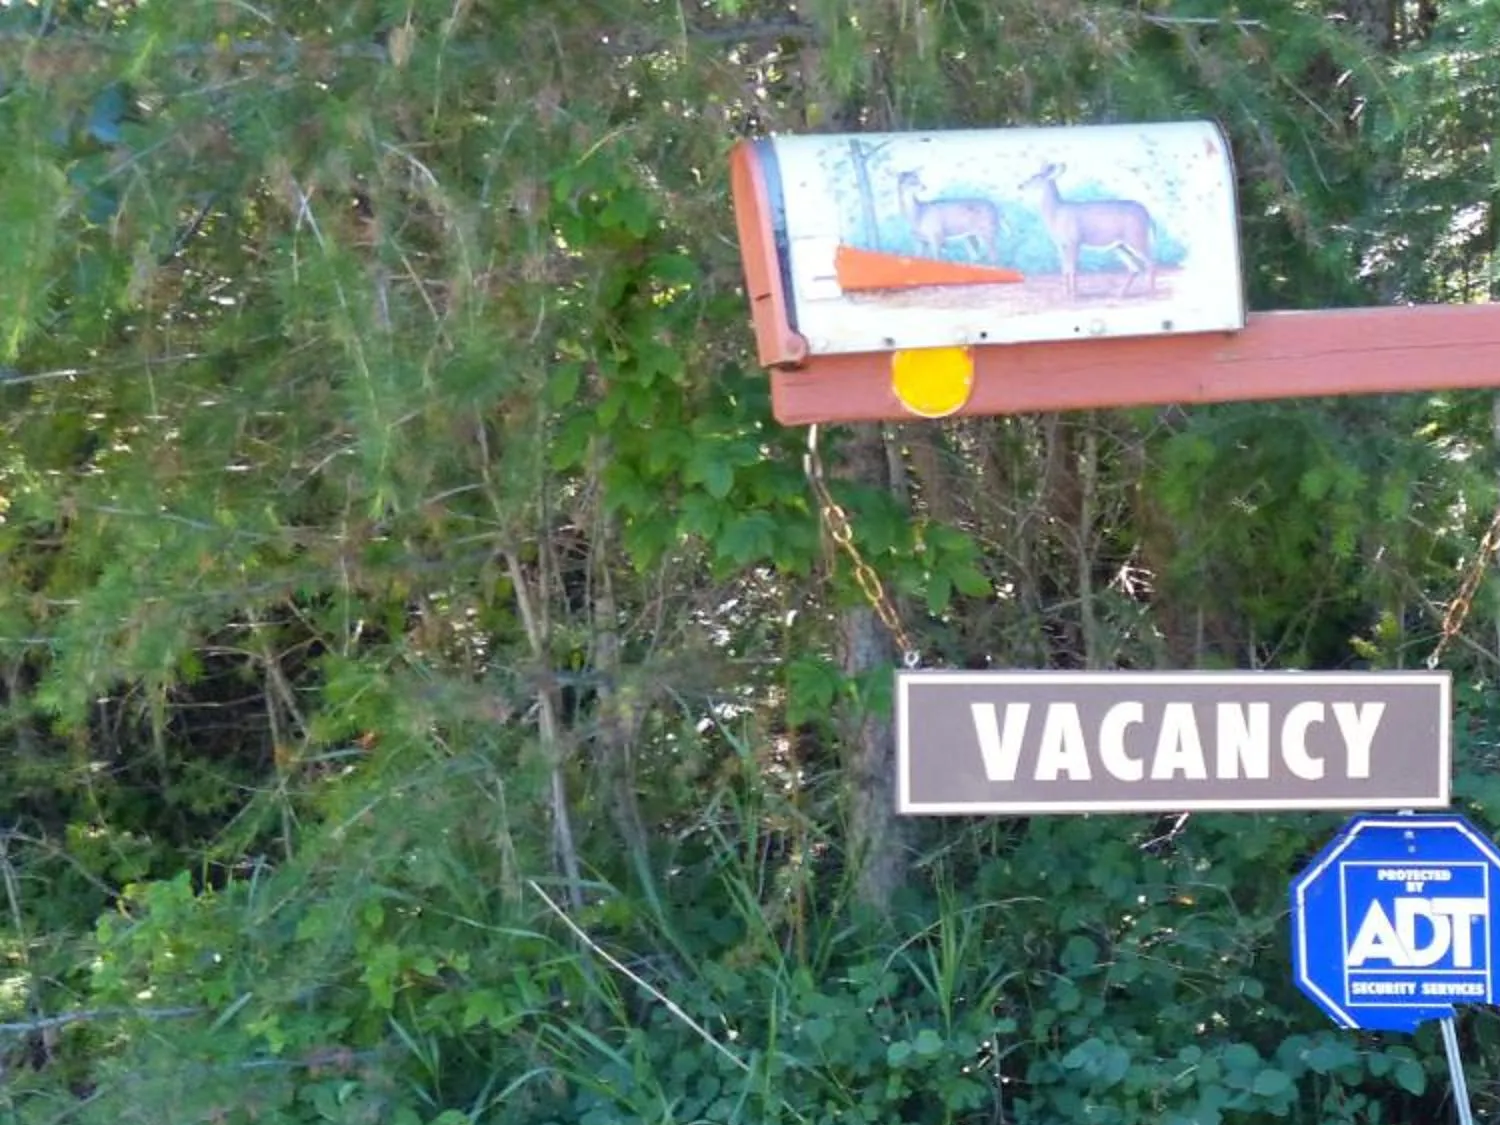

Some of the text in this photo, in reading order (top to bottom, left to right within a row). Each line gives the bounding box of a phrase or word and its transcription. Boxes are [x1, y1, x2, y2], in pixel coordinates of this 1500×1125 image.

[970, 701, 1387, 782] VACANCY
[1377, 868, 1452, 881] PROTECTED
[1406, 881, 1425, 893] BY
[1346, 897, 1488, 968] ADT
[1352, 982, 1485, 995] SECURITY SERVICES
